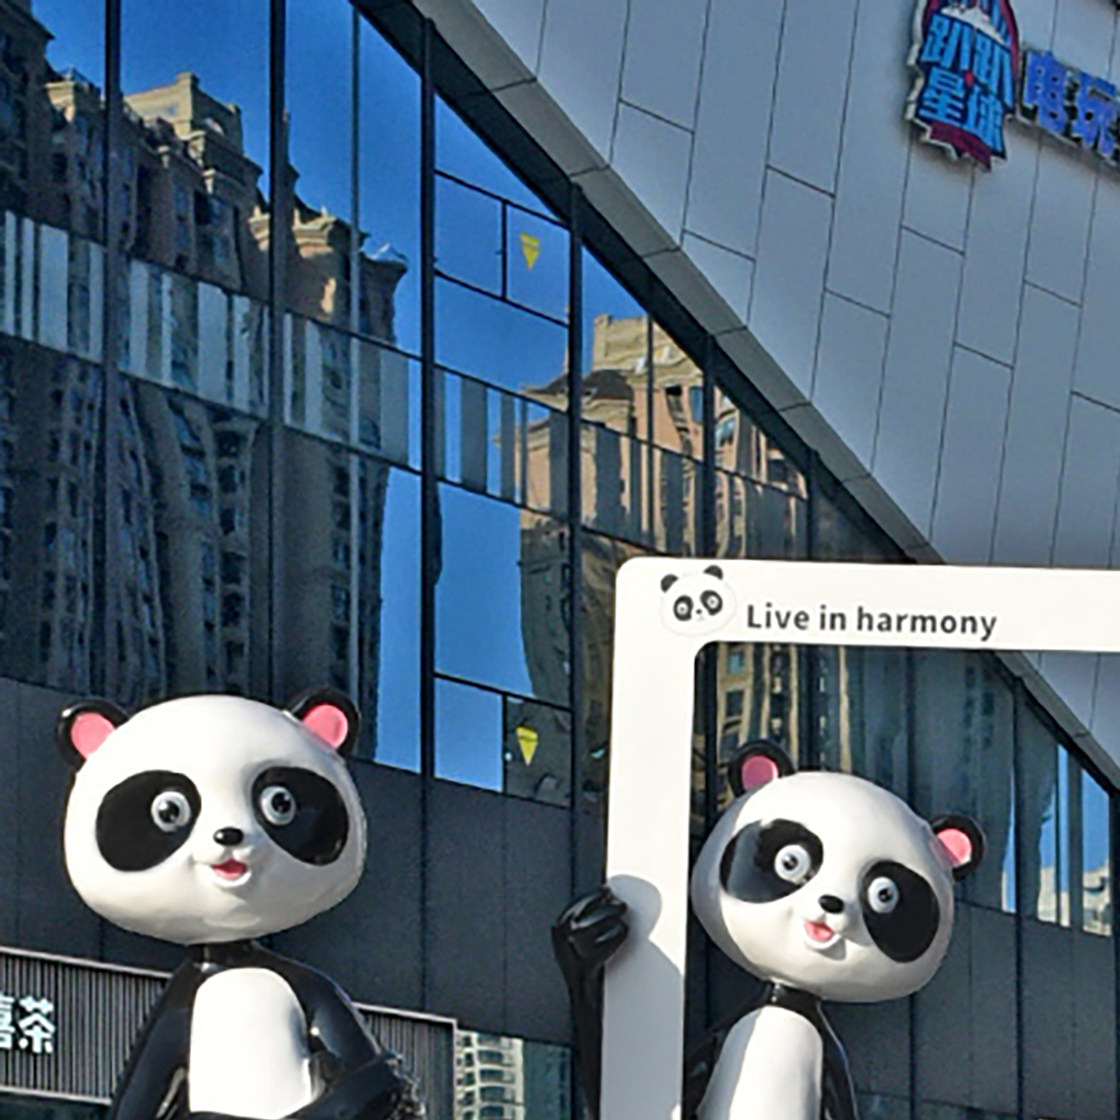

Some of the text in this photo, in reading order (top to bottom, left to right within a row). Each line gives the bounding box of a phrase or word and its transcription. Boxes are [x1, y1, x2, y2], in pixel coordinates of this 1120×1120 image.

[747, 601, 998, 642] Live in harmony
